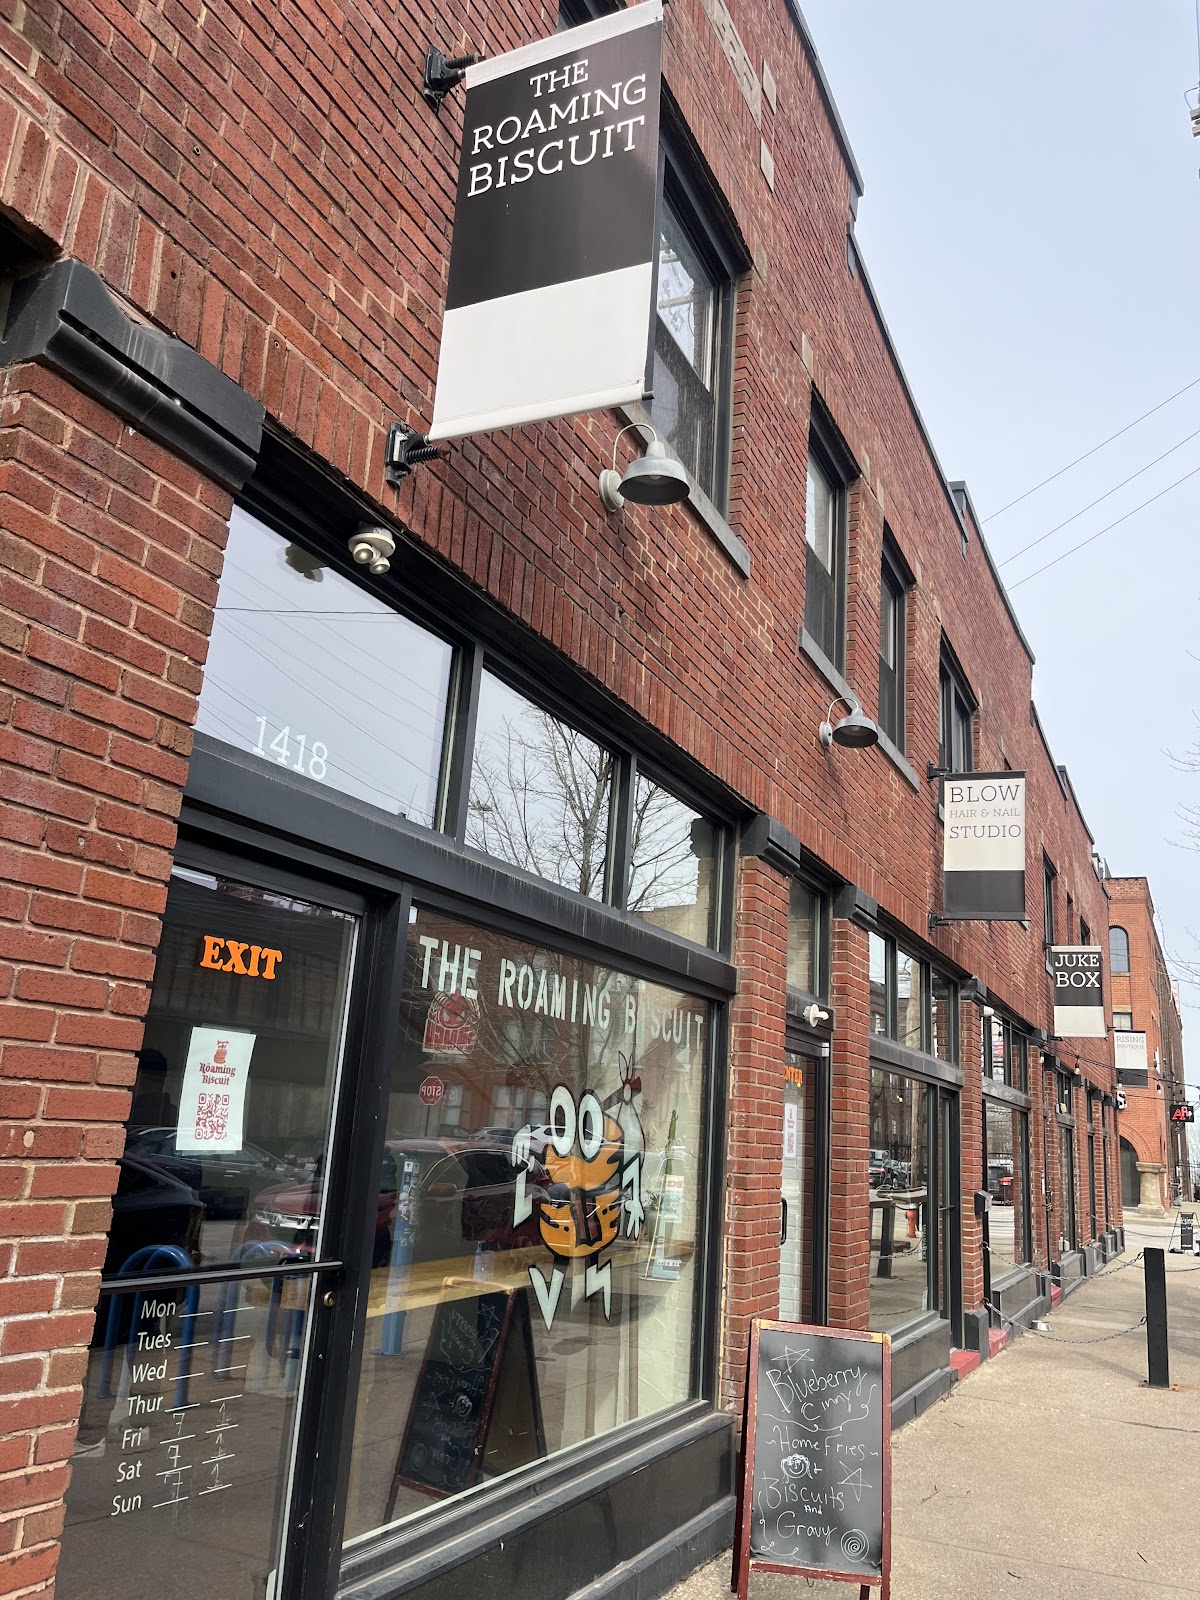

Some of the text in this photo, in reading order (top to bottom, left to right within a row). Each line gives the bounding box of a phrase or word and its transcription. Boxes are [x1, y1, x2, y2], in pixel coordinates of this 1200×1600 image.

[529, 59, 589, 97] THE
[471, 74, 646, 155] ROAMING
[467, 115, 645, 197] BISCUIT
[253, 716, 328, 780] 1418
[950, 784, 1020, 803] BLOW
[950, 808, 1021, 819] HAIR & NAIL
[949, 824, 1021, 839] STUDIO
[200, 935, 282, 980] EXIT
[1055, 954, 1100, 967] JUKE
[419, 935, 704, 1050] THE ROAMING BISCUIT
[1055, 972, 1100, 988] BOX
[1116, 1036, 1145, 1044] RISING
[202, 1075, 230, 1086] Biscuit
[141, 1301, 176, 1320] Mon
[137, 1332, 172, 1351] Tues
[132, 1359, 168, 1384] Wed
[766, 1366, 868, 1414] Blueberry
[127, 1394, 163, 1416] Thur
[121, 1427, 142, 1450] Fri
[173, 1413, 185, 1435] 7
[772, 1425, 866, 1461] Home Fries
[116, 1460, 142, 1483] Sat
[168, 1445, 181, 1468] 7
[761, 1470, 845, 1512] Biscuits
[111, 1494, 142, 1516] Sun
[804, 1503, 823, 1516] And
[776, 1511, 838, 1546] Gravy
